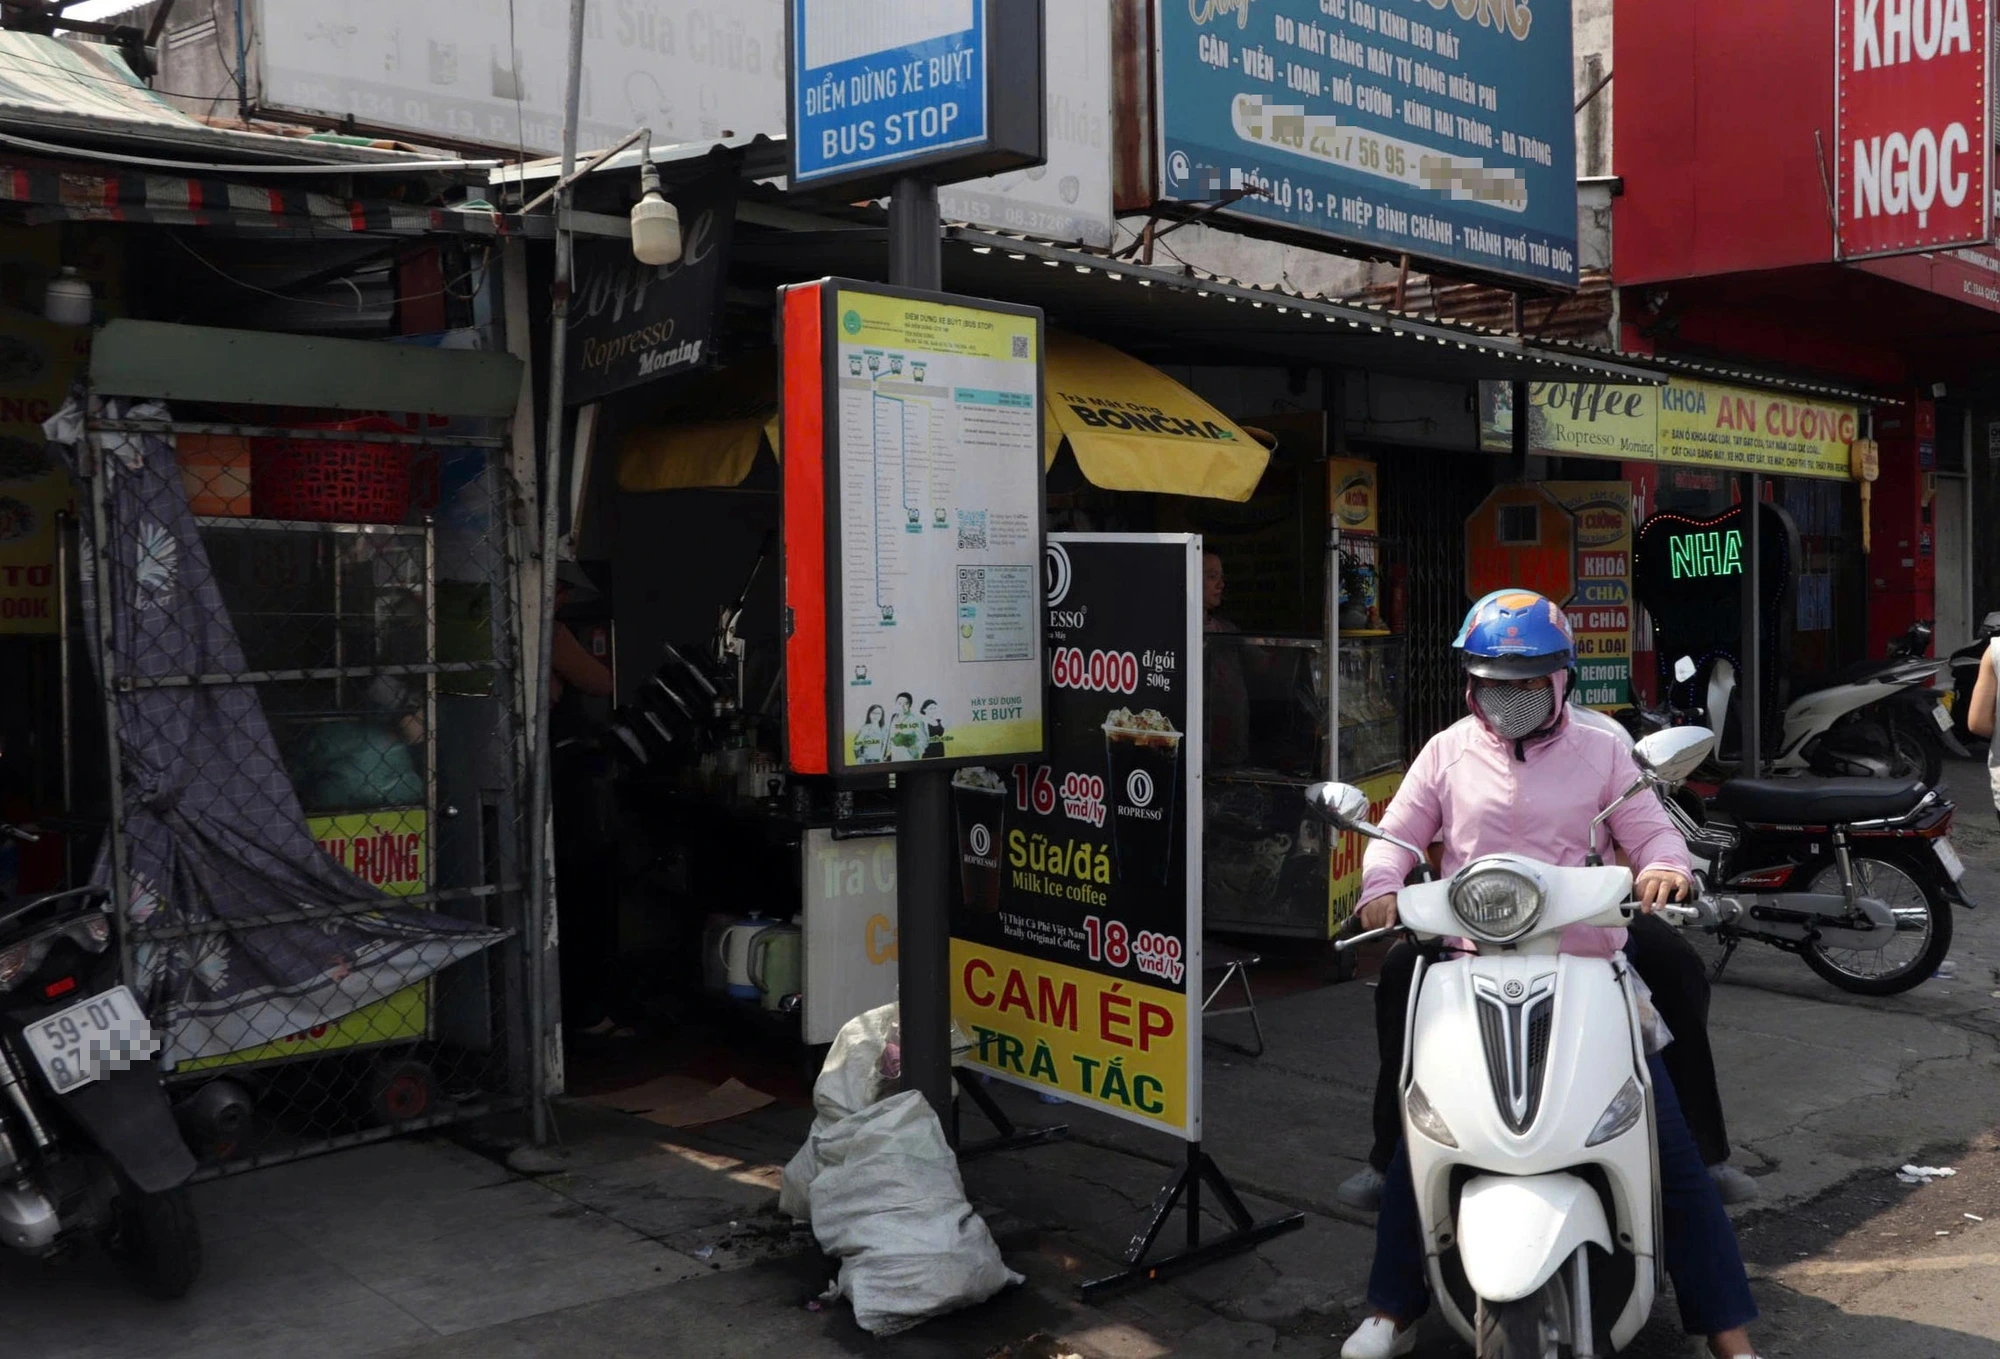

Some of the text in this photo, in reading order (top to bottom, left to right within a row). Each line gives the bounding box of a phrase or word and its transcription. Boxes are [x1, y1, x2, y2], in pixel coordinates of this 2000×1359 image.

[1350, 0, 1376, 33] LOẠI
[1380, 8, 1408, 42] KÍNH
[1436, 28, 1459, 60] MẮT
[806, 43, 974, 116] ĐIỂM DỪNG XE BUÝT
[1299, 20, 1326, 55] MẮT
[1330, 30, 1364, 69] BẰNG
[1368, 46, 1393, 78] MÁY
[1396, 56, 1412, 87] TỰ
[1415, 62, 1446, 95] ĐỘNG
[1450, 73, 1476, 105] MIỄN
[1479, 85, 1497, 111] PHÍ
[1199, 33, 1228, 70] CẬN
[1242, 45, 1274, 82] VIỄN
[1287, 62, 1320, 98] LOẠN
[1357, 82, 1393, 119] CƯỜM
[1404, 99, 1432, 130] KÍNH
[1435, 107, 1454, 137] HAI
[1456, 115, 1493, 149] TRÒNG
[822, 102, 959, 159] BUS STOP
[1359, 136, 1405, 176] 56 95
[1854, 122, 1969, 229] NGỌC
[1274, 178, 1573, 273] LỘ 13 P. HIỆP BÌNH CHÁNH THÀNH PHỐ THỦ ĐỨC
[581, 318, 675, 375] Ropresso
[638, 339, 702, 376] Morning
[1068, 404, 1239, 441] BONCHA
[1716, 395, 1756, 432] AN
[1555, 424, 1615, 446] Ropresso
[1620, 437, 1654, 457] Morning
[1585, 583, 1625, 600] CHÌA
[1588, 610, 1626, 628] CHÌA
[1142, 650, 1175, 673] đ/gói
[1598, 638, 1626, 656] LOẠI
[1146, 673, 1171, 691] 500g
[1581, 664, 1628, 680] REMOTE
[972, 705, 1022, 722] XE BUÝT
[1012, 764, 1056, 815] 16
[1064, 800, 1106, 827] vnđ/ly
[354, 826, 420, 885] RỪNG
[964, 805, 1161, 868] ROPRESSO ROPRESSO
[1009, 829, 1110, 884] Sữa/đá
[1013, 870, 1107, 906] Milk Ice coffee
[1004, 925, 1081, 951] Really Original Coffee
[1009, 913, 1024, 927] Thật
[1026, 916, 1036, 928] Cà
[1037, 919, 1051, 932] Phê
[1052, 923, 1067, 937] Việt
[1068, 927, 1085, 940] Nam
[1084, 915, 1128, 967] 18
[1138, 954, 1184, 984] vnđ/ly
[963, 958, 1174, 1052] CAM ÉP
[971, 1025, 1164, 1114] TRÀ TẮC
